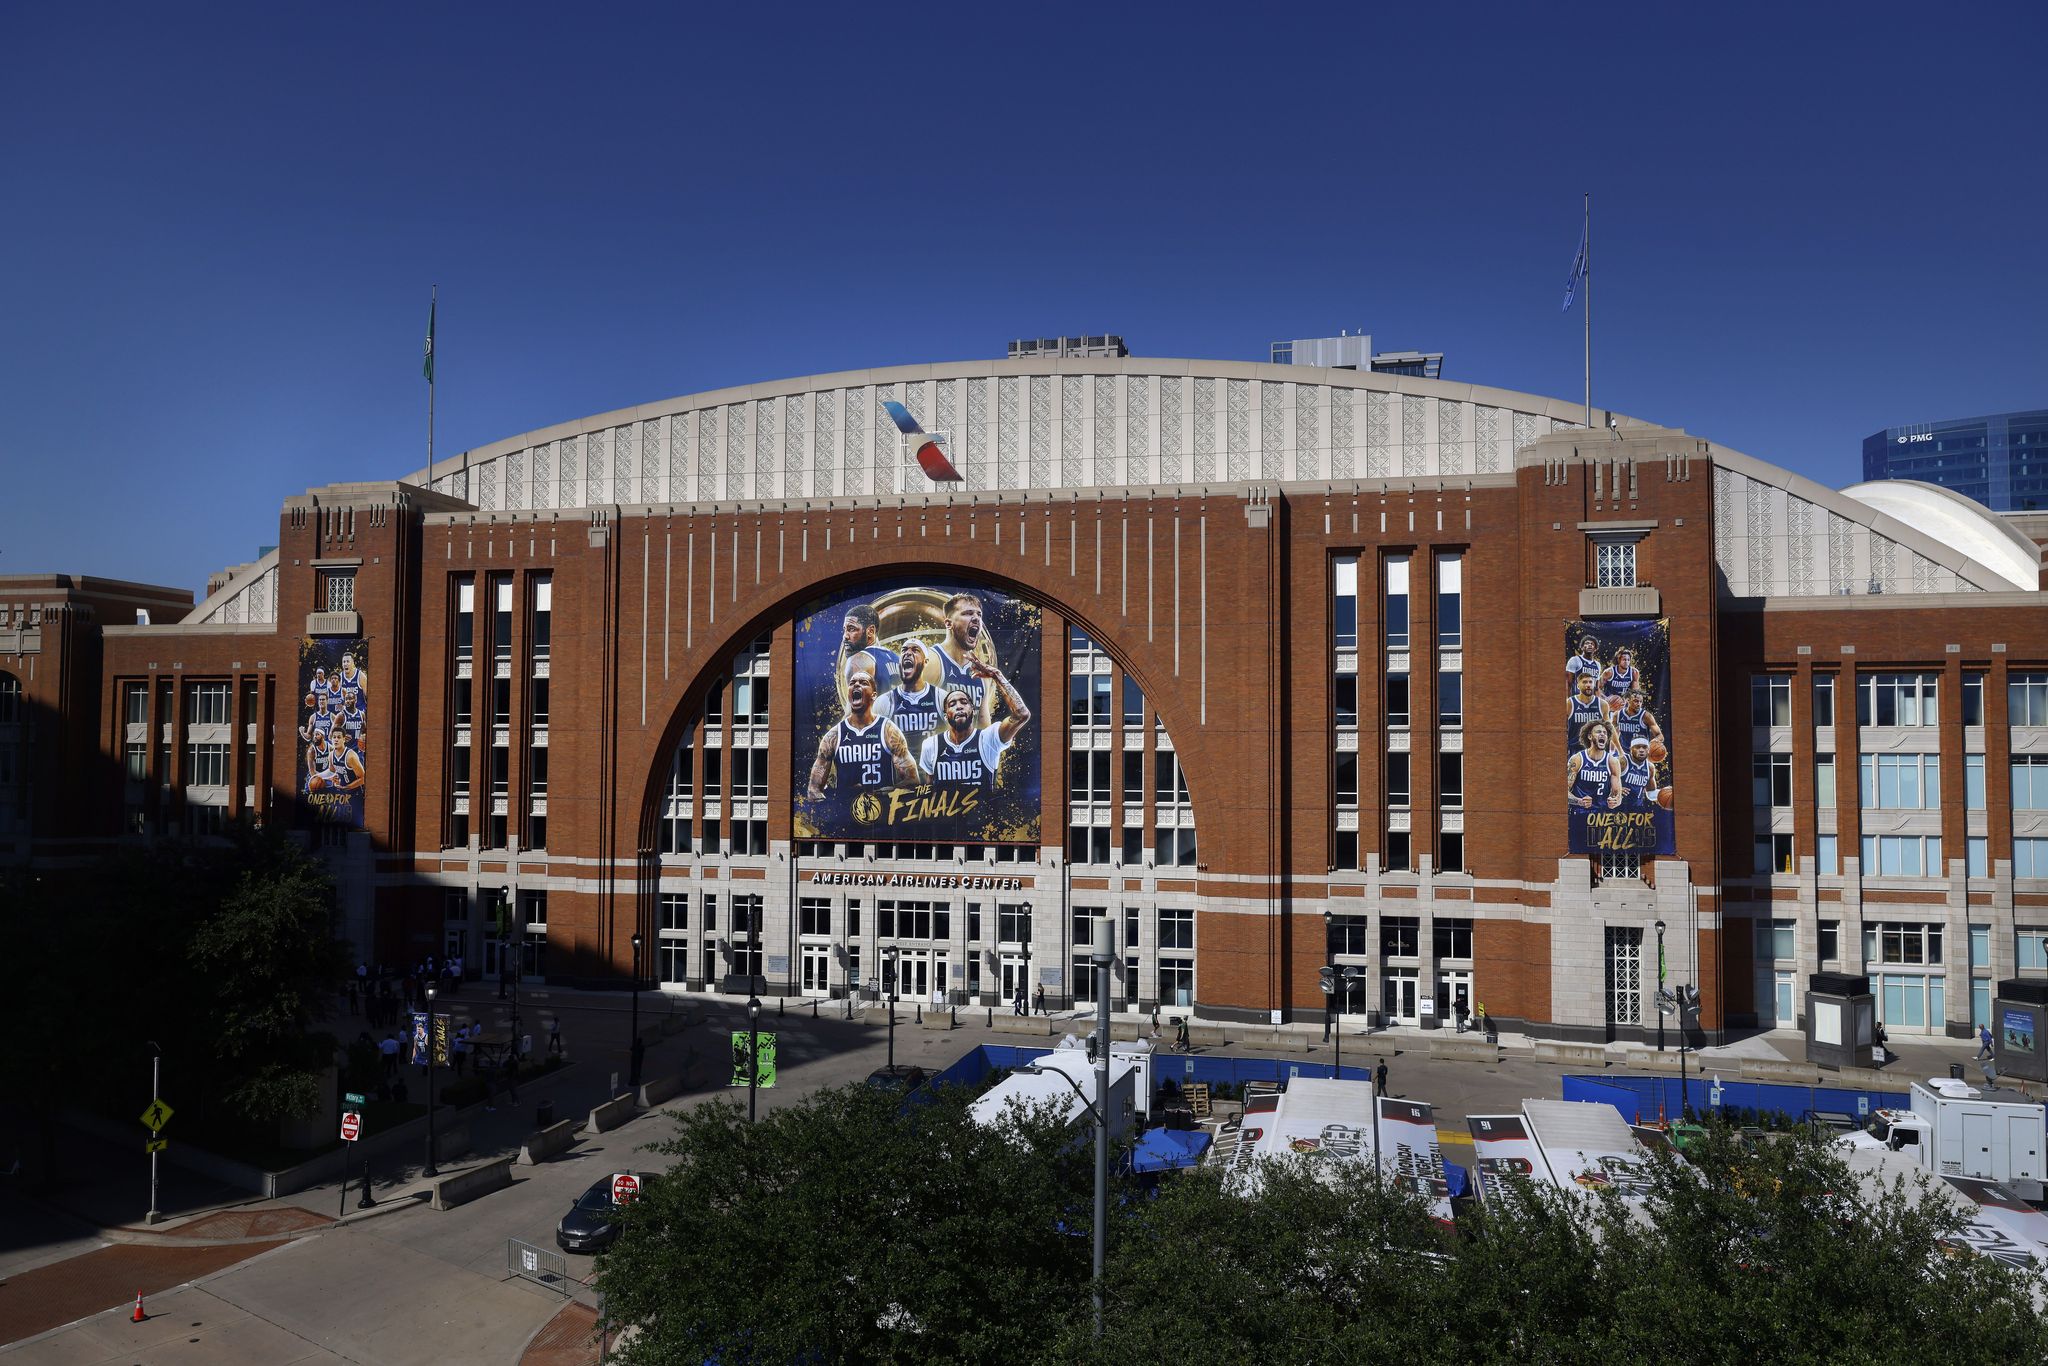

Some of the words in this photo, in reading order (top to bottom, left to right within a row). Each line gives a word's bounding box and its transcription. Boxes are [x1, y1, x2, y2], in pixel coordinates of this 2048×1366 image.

[1910, 433, 1933, 443] PMG
[946, 682, 983, 707] MVS
[893, 711, 938, 732] MAVS
[1574, 712, 1600, 723] MAVS
[839, 743, 882, 764] MAVS
[861, 763, 882, 785] 25
[937, 759, 982, 781] MAVS
[1580, 769, 1608, 782] MAVS
[1625, 772, 1649, 787] MAVS
[915, 784, 934, 797] THE
[1597, 783, 1605, 796] 2
[308, 793, 326, 805] ONE
[334, 794, 352, 805] FOR
[887, 787, 979, 826] FINALS
[1587, 812, 1614, 827] ONE
[1627, 812, 1655, 828] FOR
[1597, 826, 1636, 849] ALL
[811, 871, 885, 885] AMERICAN
[890, 873, 957, 887] AIRLINES
[961, 876, 1021, 889] CENTER
[1411, 1108, 1421, 1118] 16
[1397, 1142, 1415, 1176] MONDAY
[1414, 1153, 1433, 1179] NIGHT
